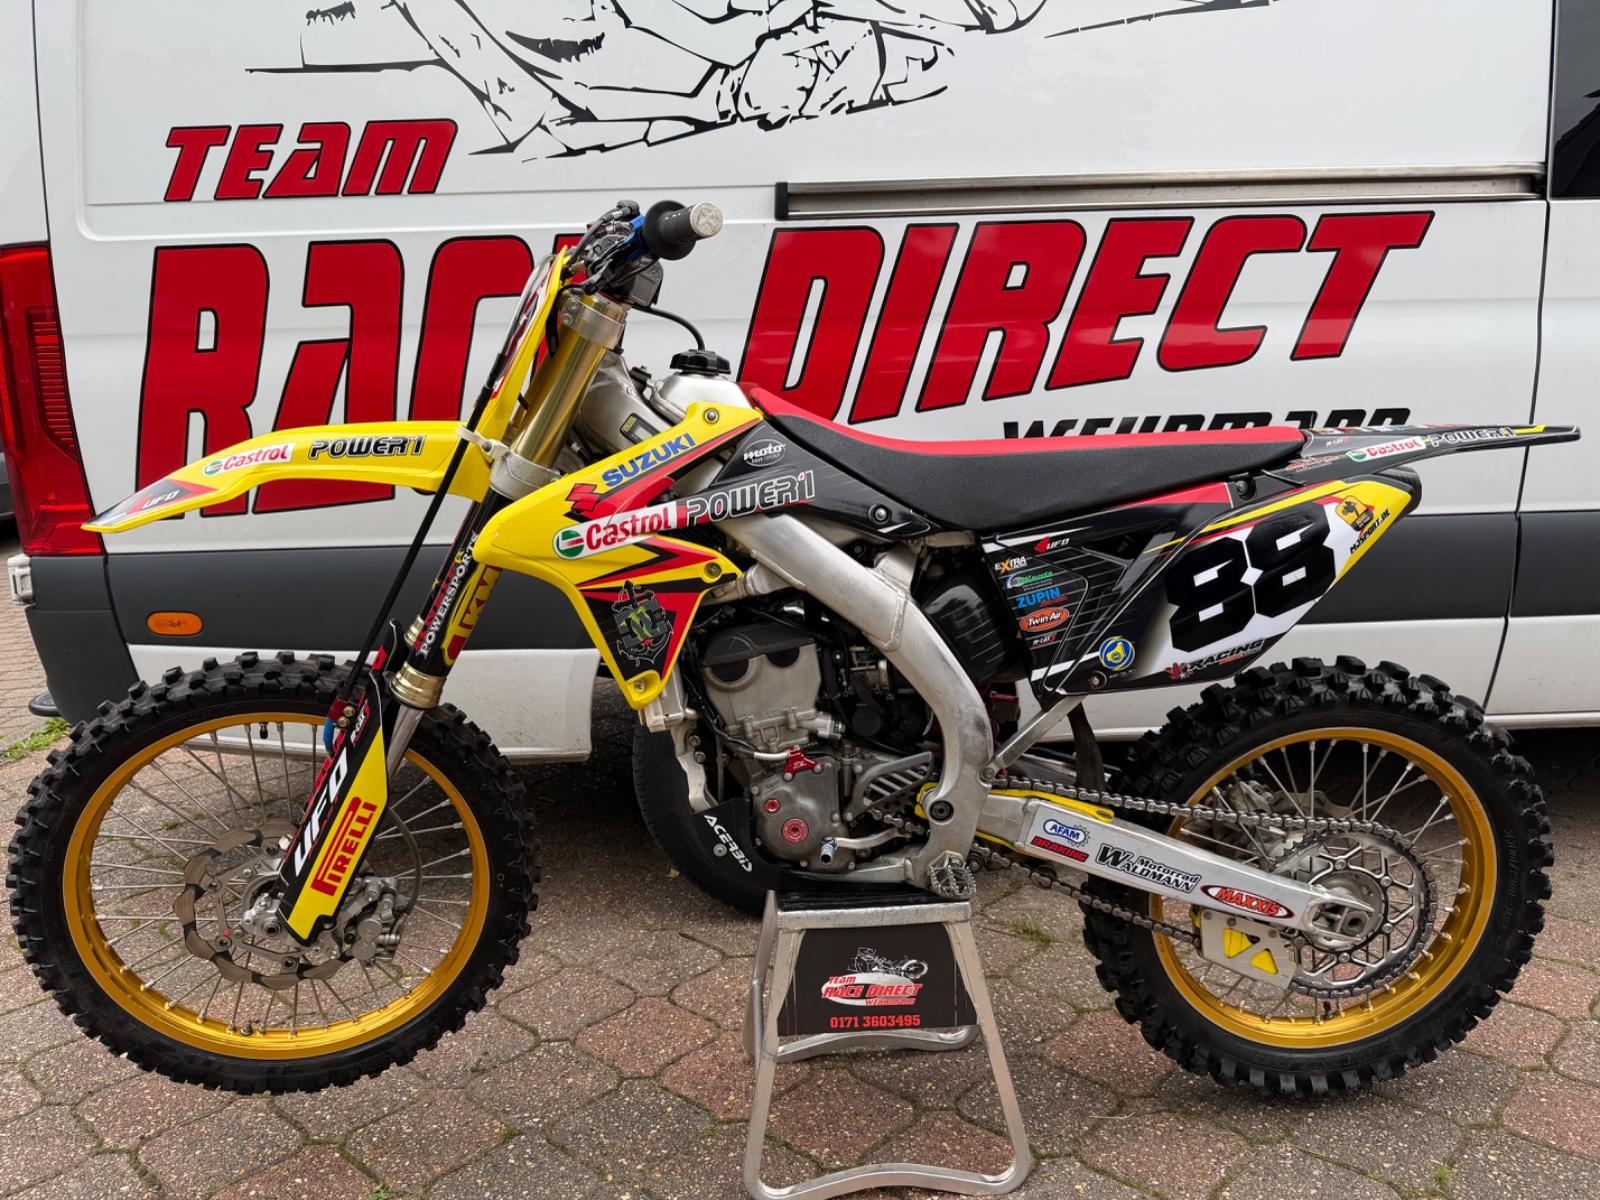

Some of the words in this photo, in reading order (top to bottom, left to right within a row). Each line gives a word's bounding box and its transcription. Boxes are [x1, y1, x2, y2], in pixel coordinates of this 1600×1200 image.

[164, 118, 457, 203] TEAM
[735, 211, 1435, 424] DIRECT
[224, 446, 288, 470] Castrol
[308, 434, 425, 459] POWER1
[601, 432, 696, 488] SUZUKI
[743, 442, 786, 461] moto
[1366, 436, 1421, 458] Castrol
[142, 488, 179, 509] UFO
[585, 507, 672, 550] Castrol
[684, 469, 816, 528] POWER1
[1046, 538, 1070, 550] UFO
[1167, 509, 1337, 653] 88
[1015, 586, 1063, 609] ZUPIN
[1027, 614, 1049, 627] Twin
[1049, 611, 1063, 622] Air
[293, 747, 349, 877] UFO
[310, 796, 379, 897] PIRELLI
[1050, 824, 1081, 841] AFAM
[1031, 837, 1089, 862] BRAKING
[1096, 844, 1200, 893] WALDMANN
[1137, 856, 1201, 884] Motorrad
[1214, 887, 1281, 917] MAXXIS
[822, 985, 864, 998] RACE
[865, 983, 923, 998] DIRECT
[830, 1016, 859, 1028] 0171
[862, 1014, 921, 1027] 3603495
